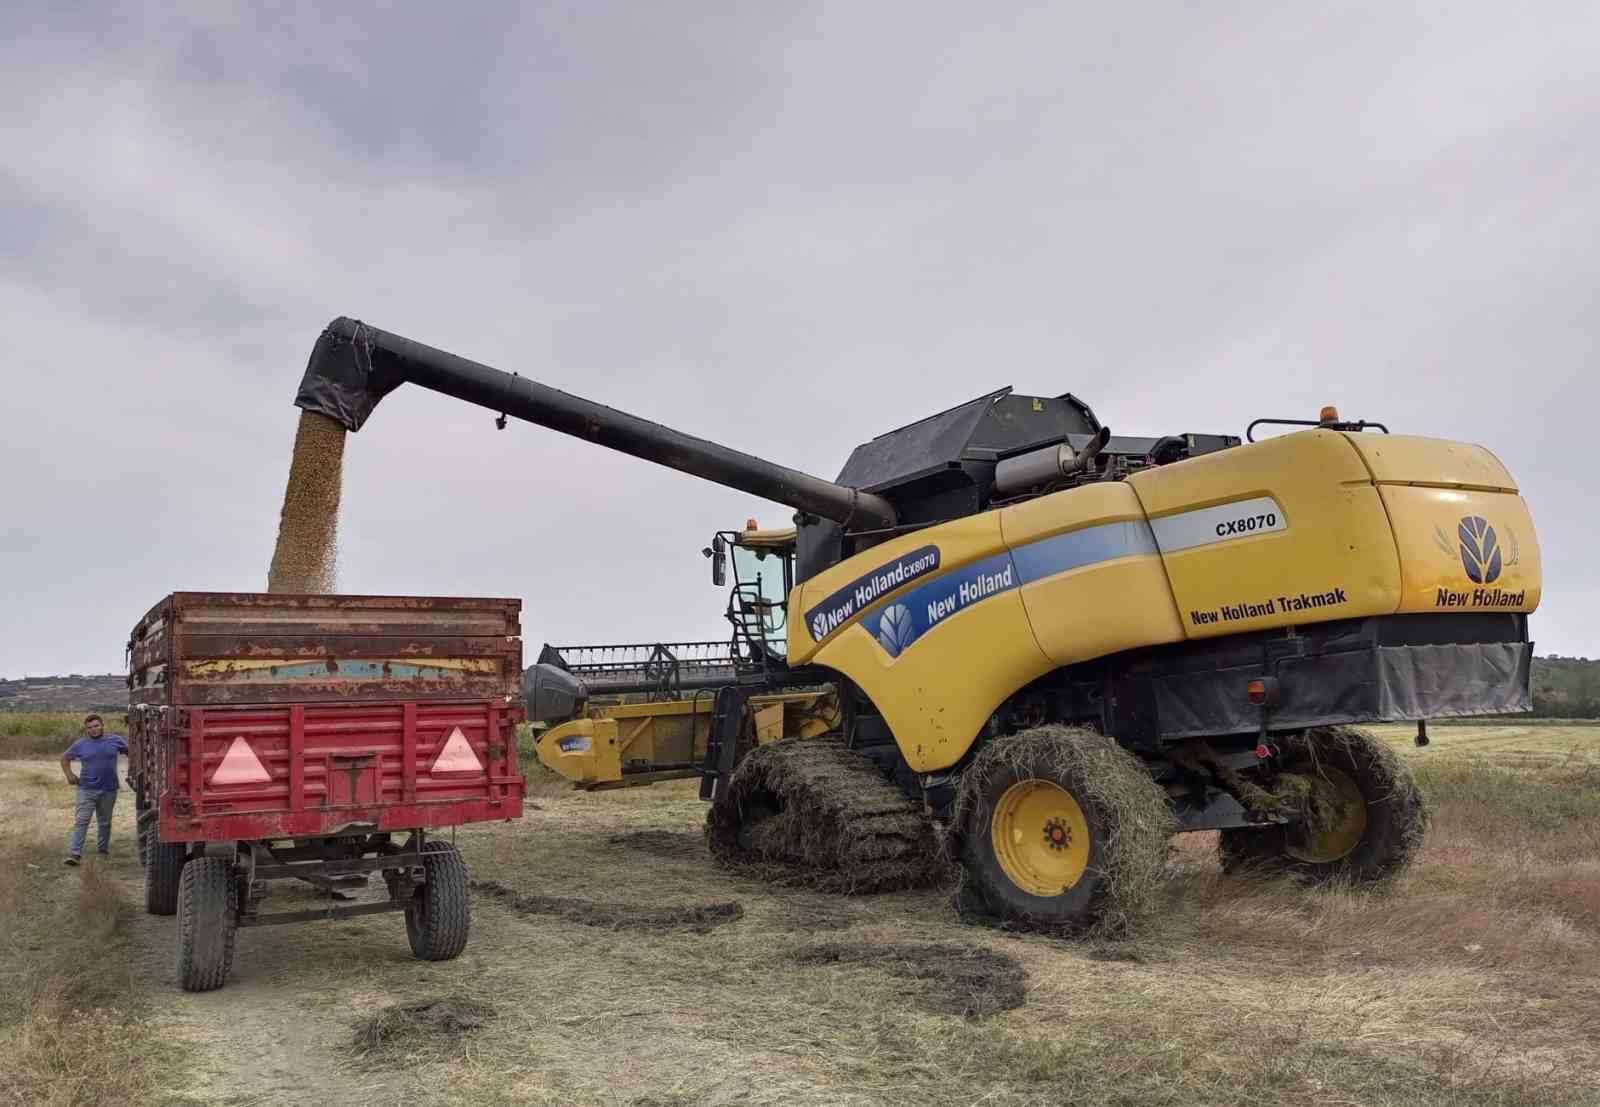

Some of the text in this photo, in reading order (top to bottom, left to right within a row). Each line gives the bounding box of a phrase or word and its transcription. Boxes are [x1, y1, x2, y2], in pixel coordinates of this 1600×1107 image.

[1216, 513, 1276, 536] CX8070
[827, 552, 935, 631] New Holland CX8070
[928, 564, 1012, 624] New Holland
[1190, 588, 1347, 625] New Holland Trakmak
[1436, 588, 1525, 607] New Holland
